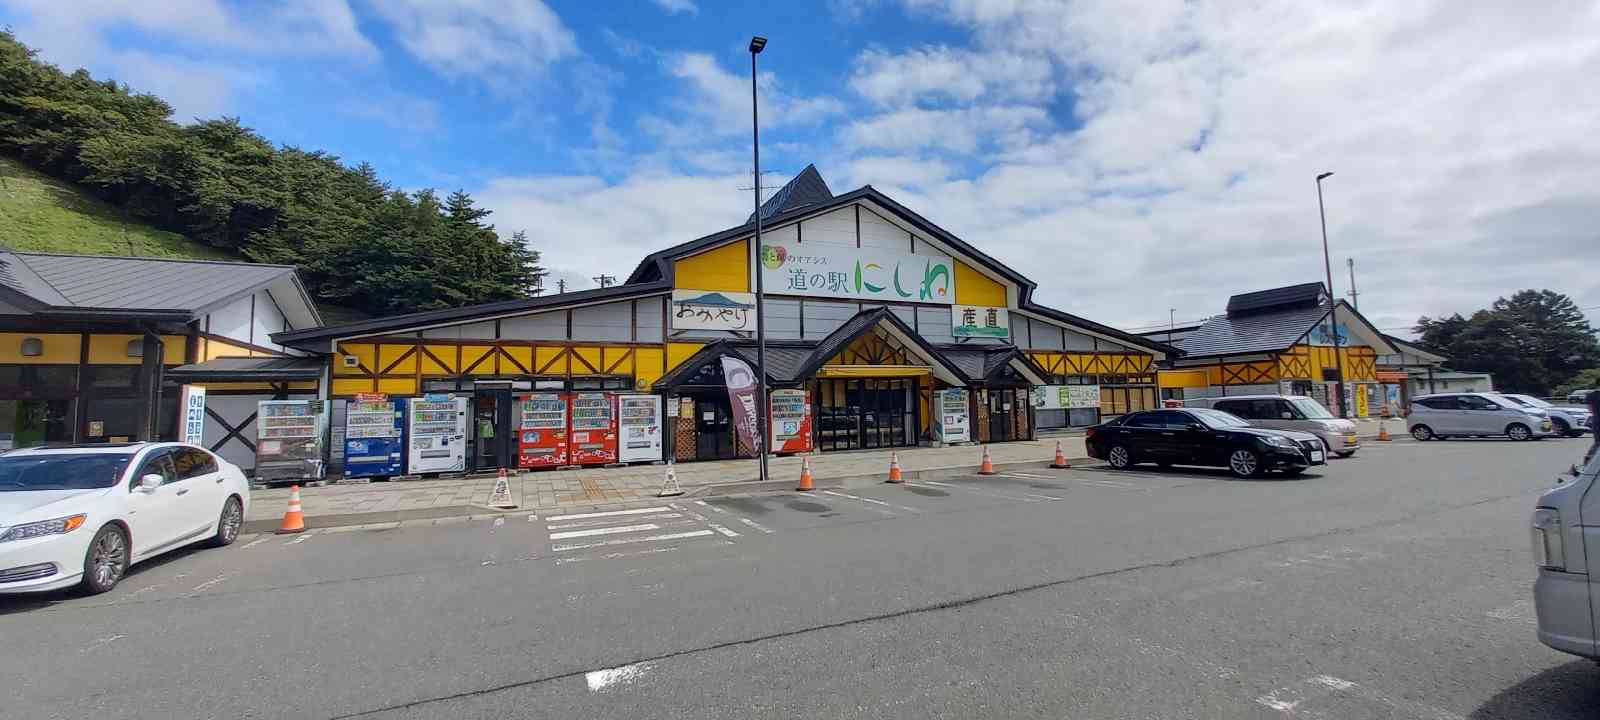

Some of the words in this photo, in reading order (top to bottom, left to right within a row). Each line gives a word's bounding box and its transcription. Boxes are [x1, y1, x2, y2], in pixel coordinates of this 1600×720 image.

[788, 268, 849, 293] 道の駅
[854, 257, 950, 300] にしね
[961, 308, 1001, 328] 産直
